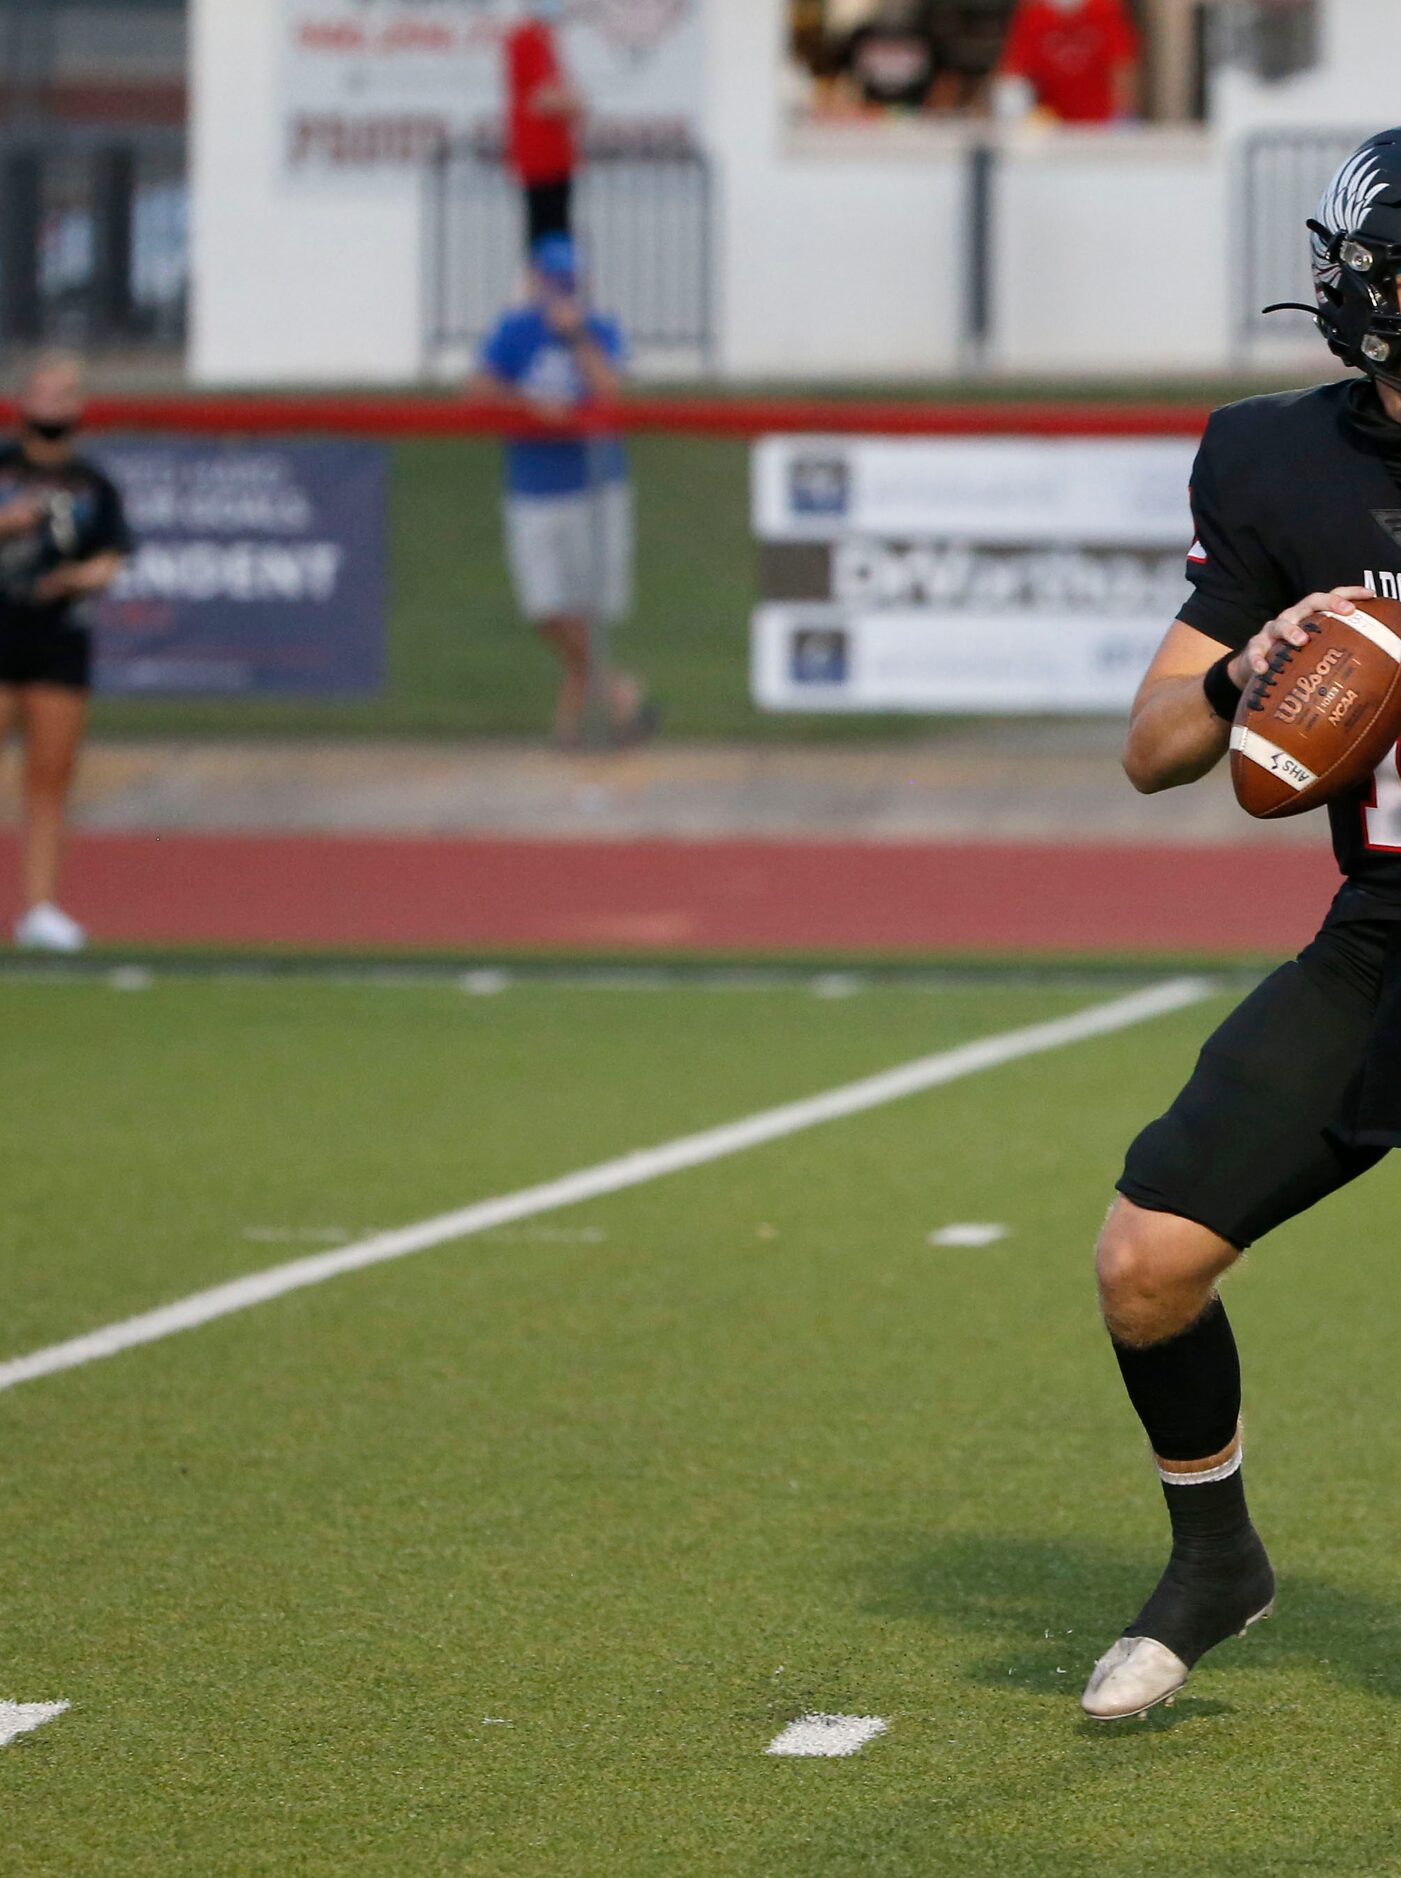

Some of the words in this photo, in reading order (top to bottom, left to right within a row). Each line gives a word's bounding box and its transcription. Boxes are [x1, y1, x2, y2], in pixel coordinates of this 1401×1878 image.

[1272, 647, 1344, 725] Wilson
[1327, 688, 1359, 727] NCAA
[1281, 759, 1311, 783] AHS
